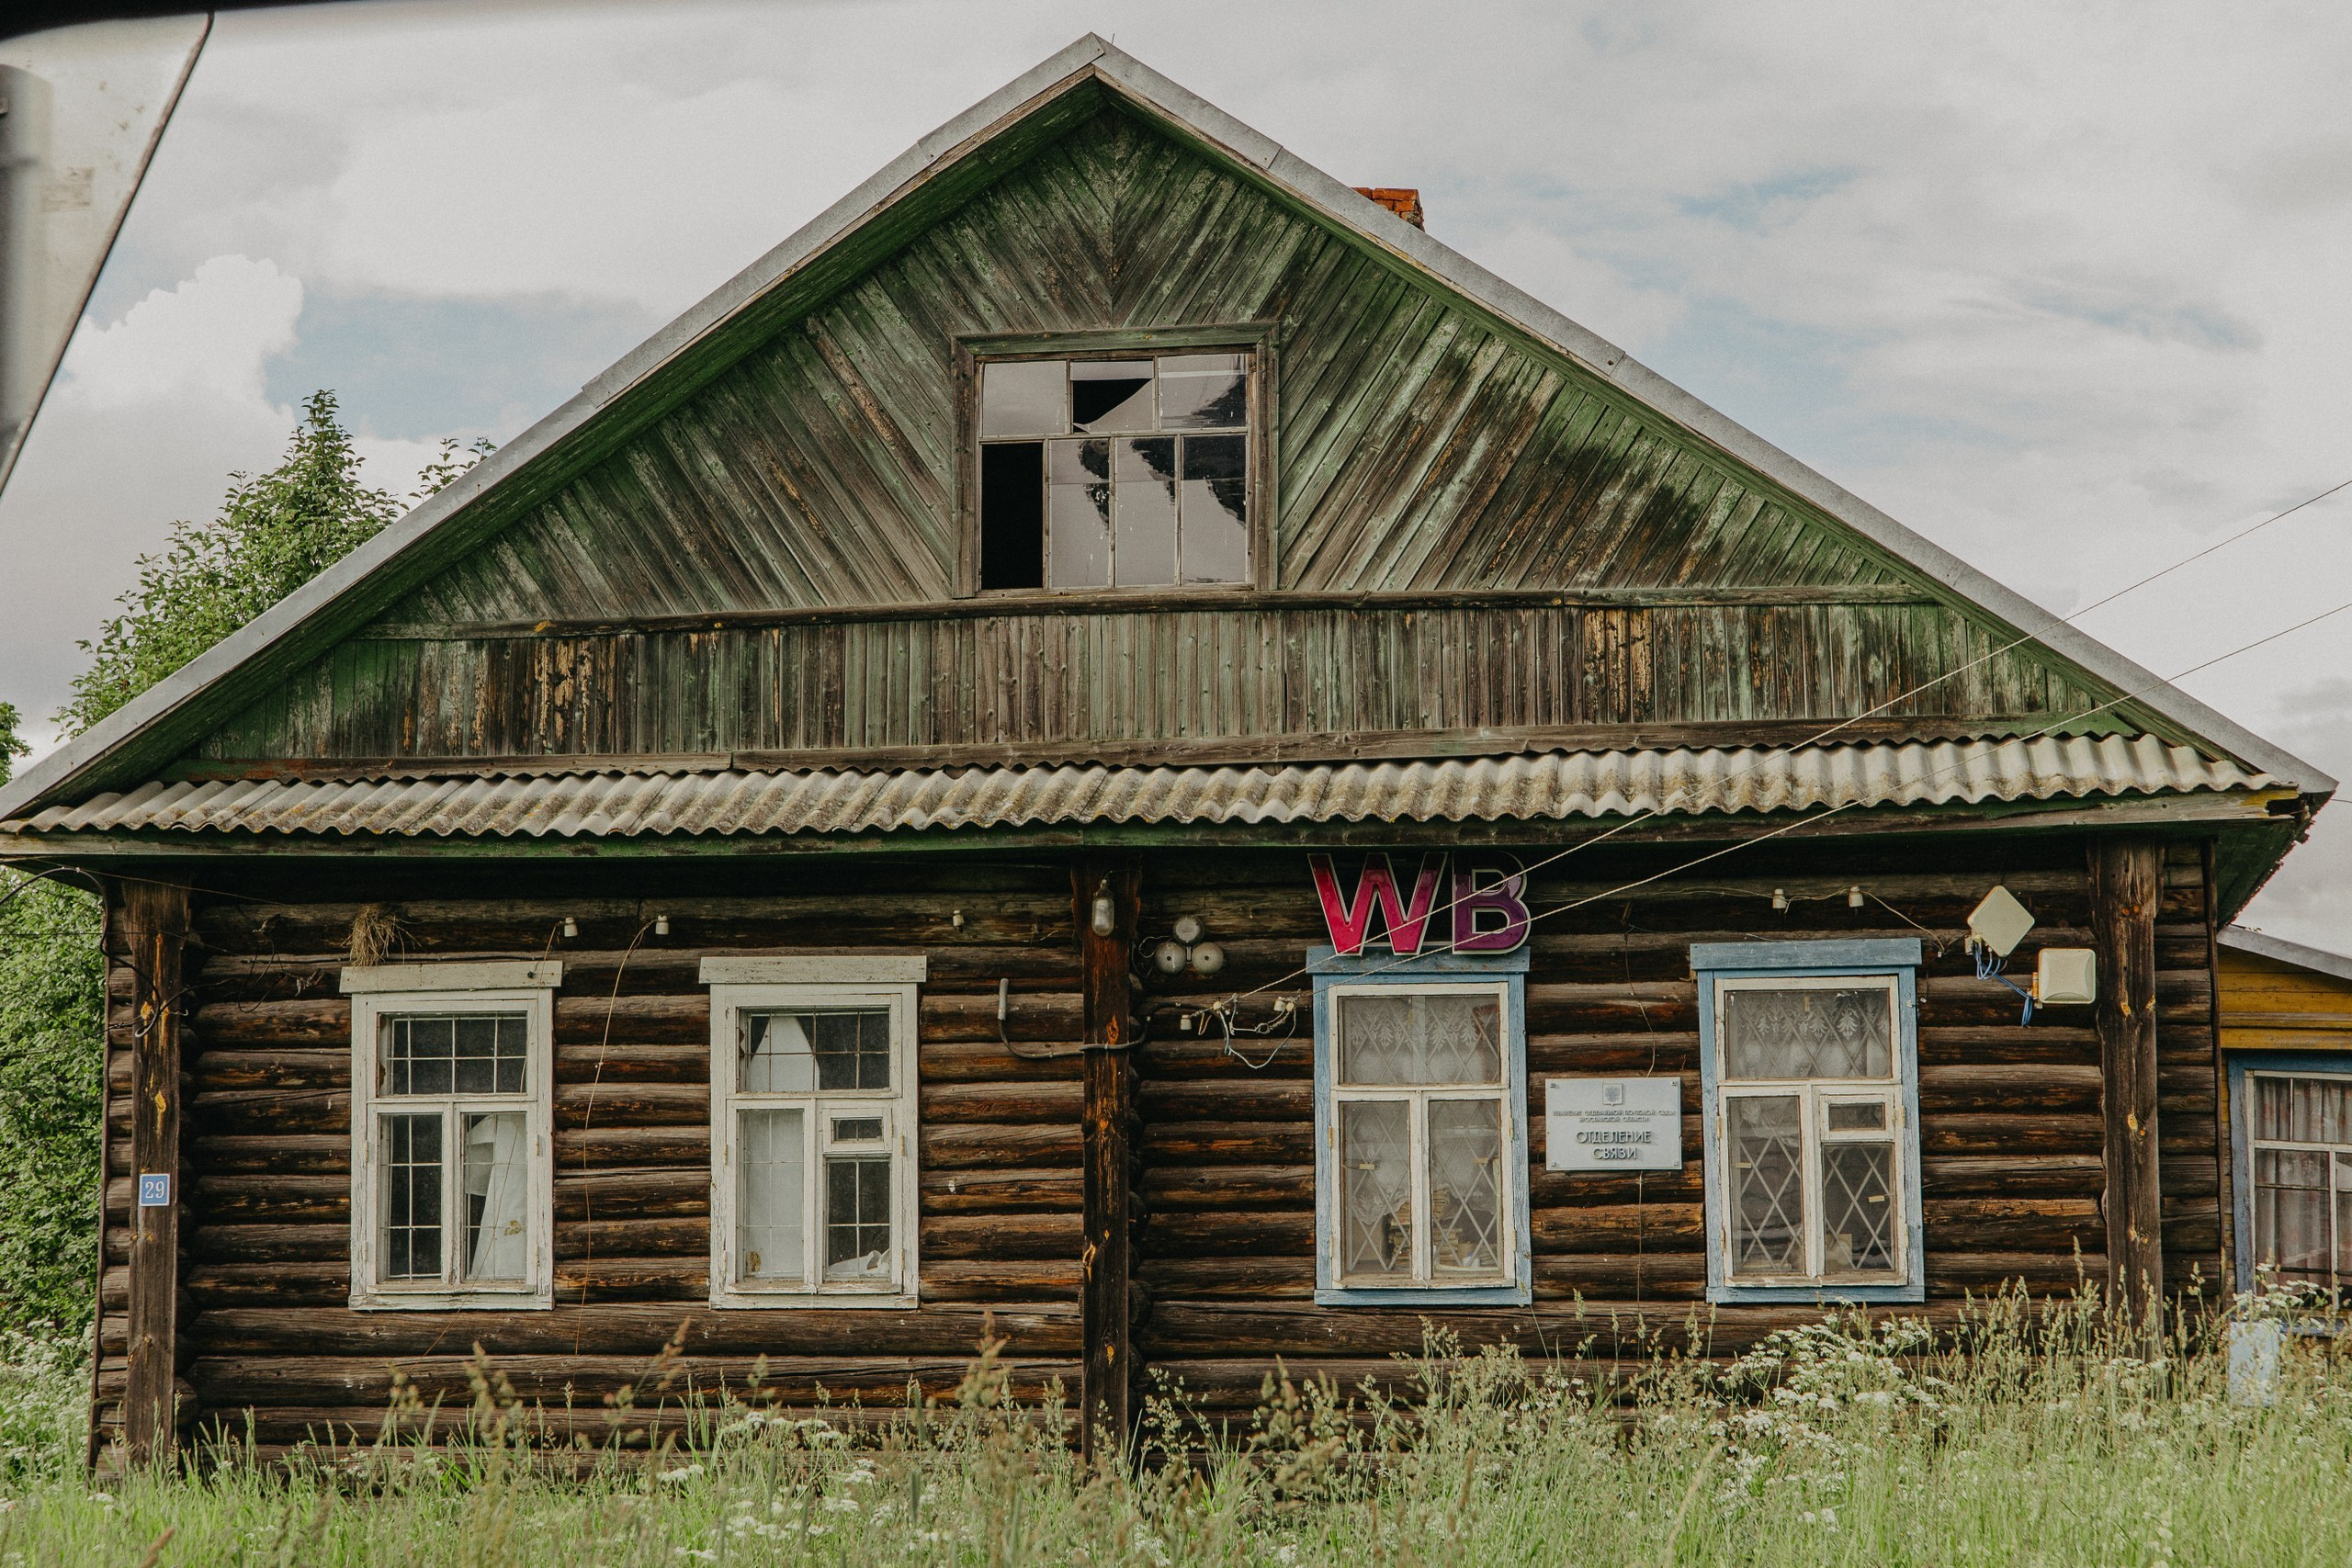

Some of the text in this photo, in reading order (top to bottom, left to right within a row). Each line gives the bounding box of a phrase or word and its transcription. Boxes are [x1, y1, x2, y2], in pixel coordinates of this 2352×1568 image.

[1306, 852, 1532, 956] WB
[1576, 1131, 1652, 1144] ОТДЕЛЕНИЕ
[1593, 1147, 1636, 1160] СВЯЗИ
[145, 1181, 164, 1199] 29
